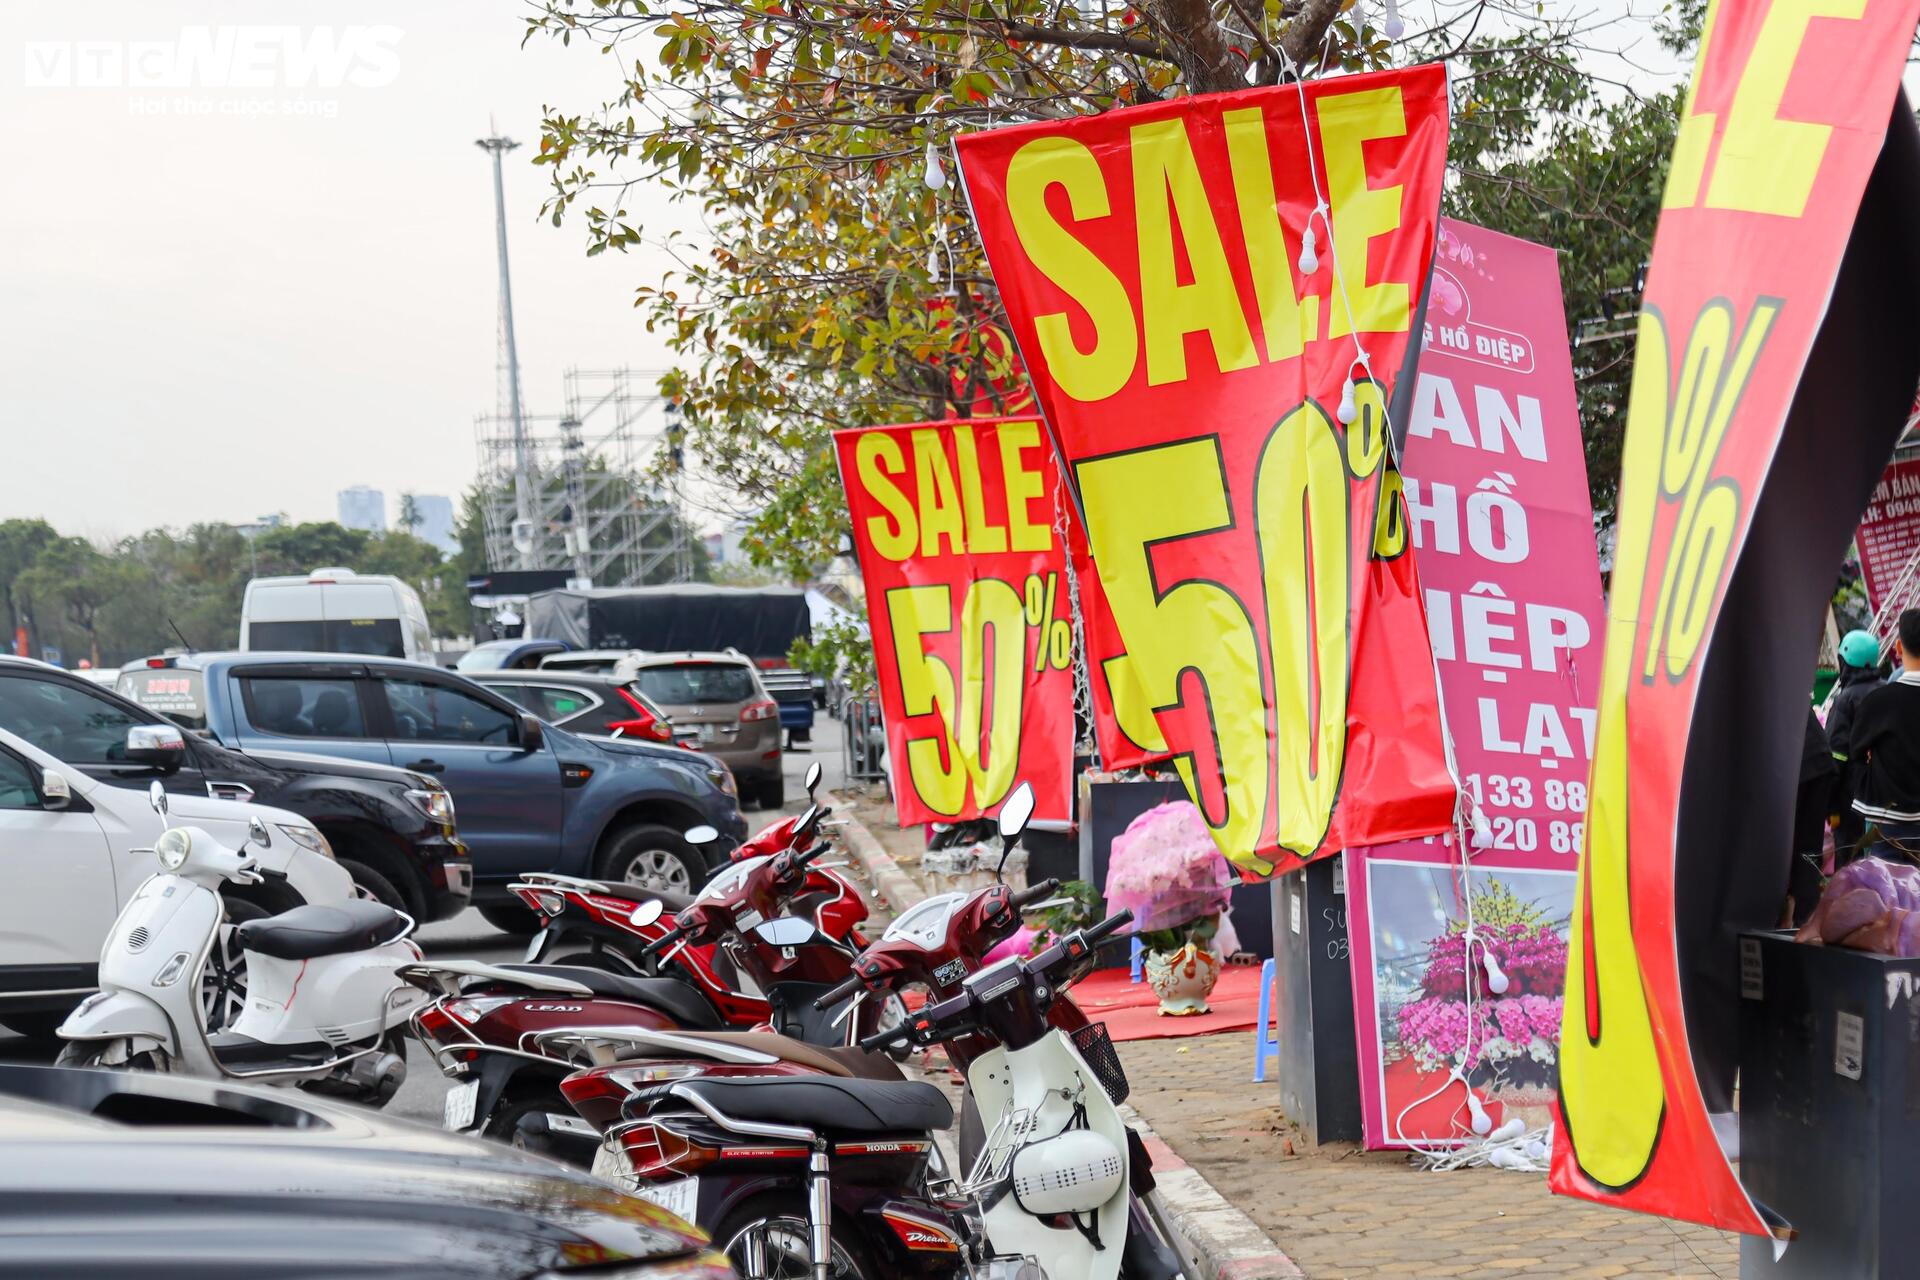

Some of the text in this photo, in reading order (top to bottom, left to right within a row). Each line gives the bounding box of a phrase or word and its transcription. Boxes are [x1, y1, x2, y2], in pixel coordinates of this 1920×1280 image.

[1005, 86, 1410, 402] SALE
[1440, 325, 1469, 350] HỒ
[1476, 335, 1525, 364] ĐIỆP
[1409, 372, 1547, 463] AN
[855, 420, 1053, 562] SALE
[1403, 471, 1529, 563] HỒ
[1426, 581, 1591, 683] IỆP
[886, 571, 1072, 818] 50%
[1544, 779, 1587, 813] 88
[1471, 817, 1586, 854] 20 88
[524, 1004, 583, 1012] LEAD
[866, 1144, 900, 1152] HONDA
[906, 1232, 946, 1243] Dream
